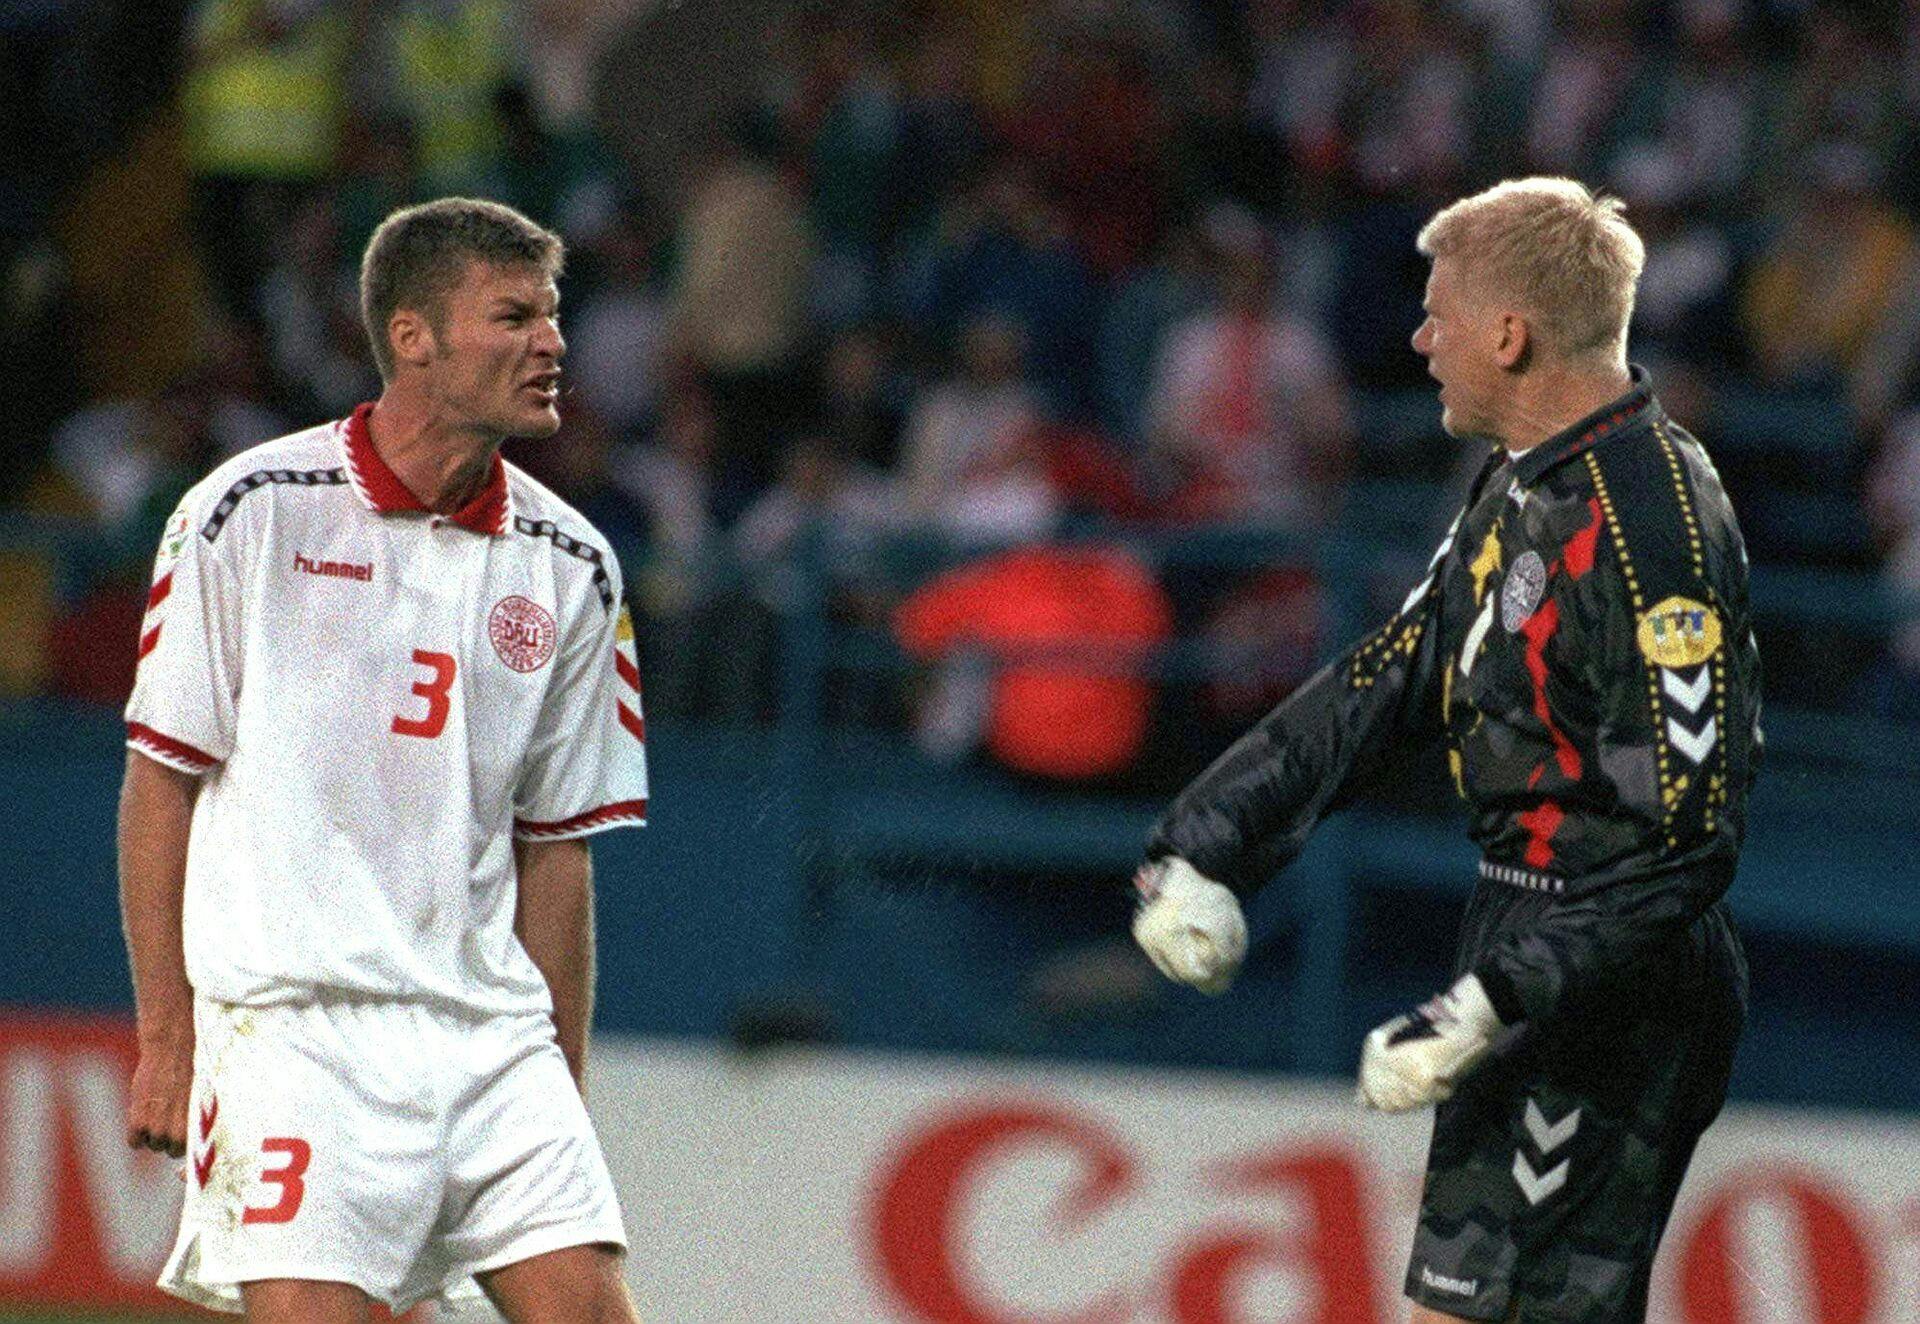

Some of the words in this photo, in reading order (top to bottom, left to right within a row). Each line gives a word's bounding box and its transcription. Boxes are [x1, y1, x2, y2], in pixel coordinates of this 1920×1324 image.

[294, 551, 374, 582] hummel
[390, 649, 456, 739] 3
[241, 1137, 312, 1224] 3
